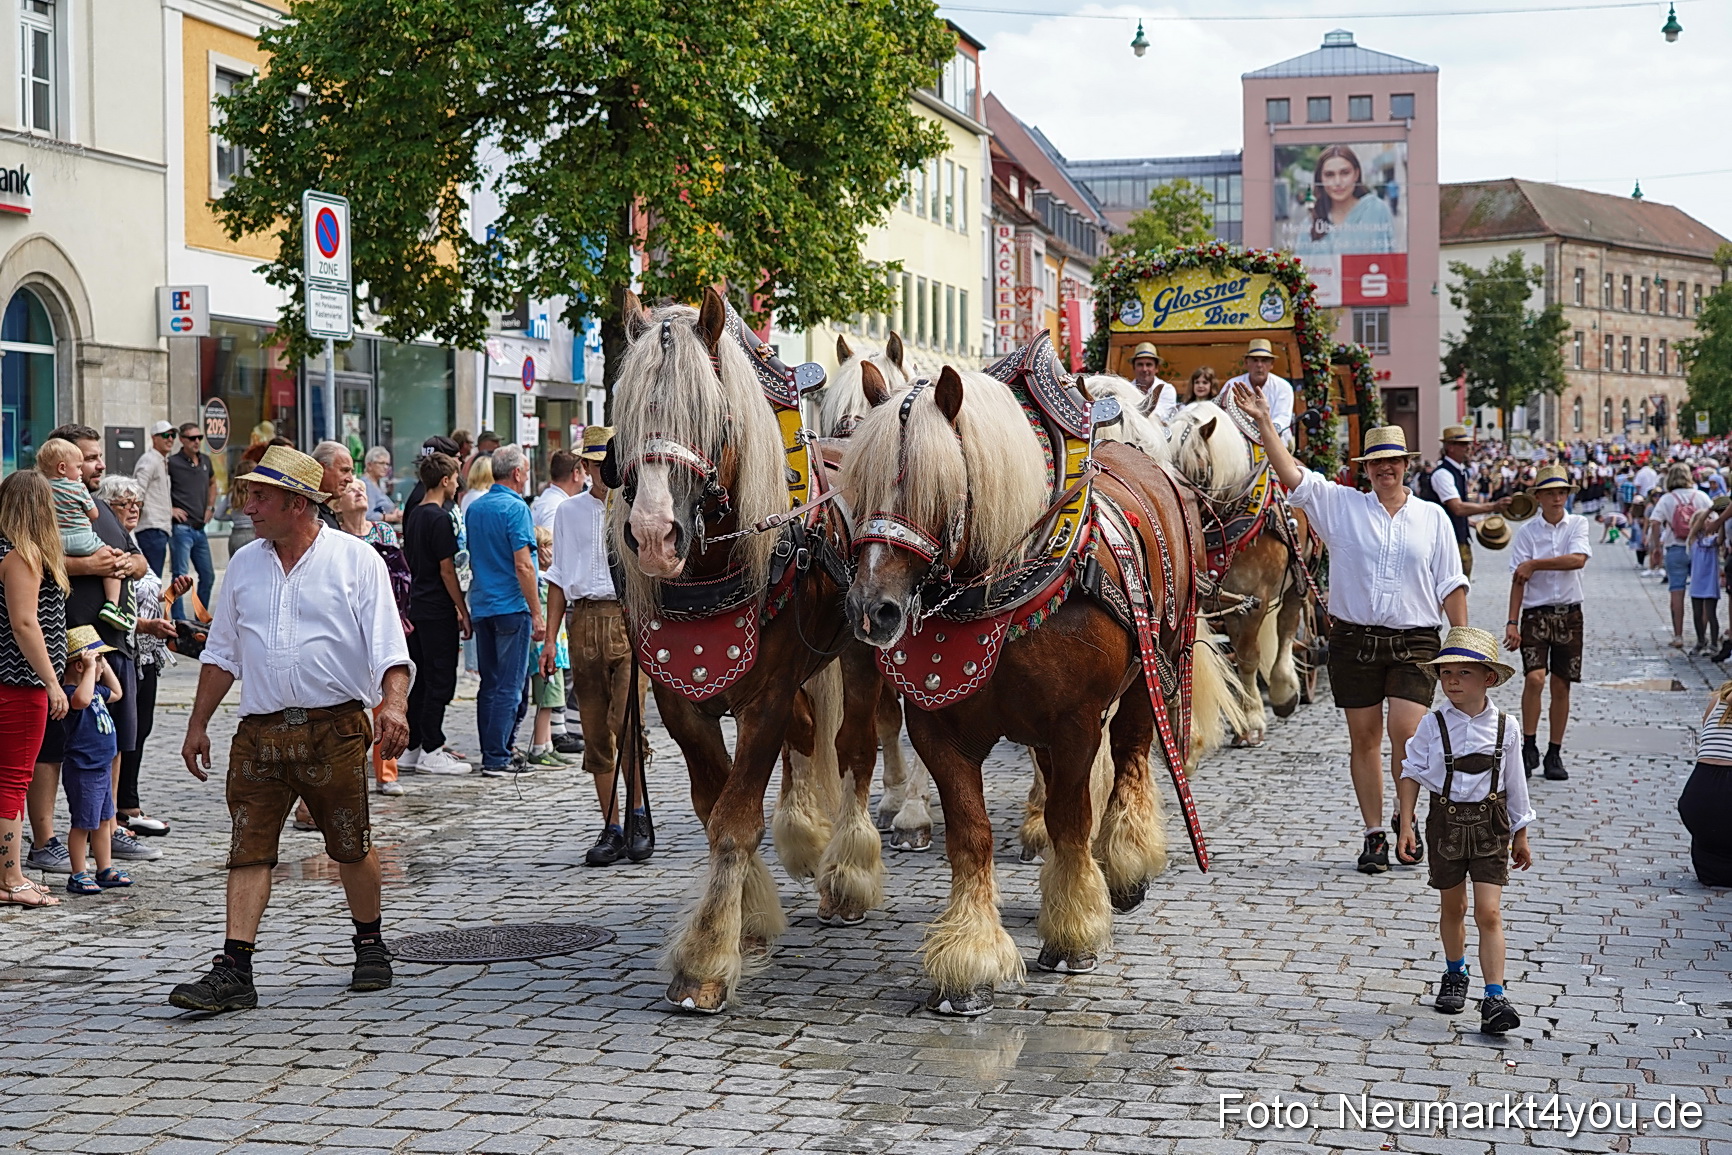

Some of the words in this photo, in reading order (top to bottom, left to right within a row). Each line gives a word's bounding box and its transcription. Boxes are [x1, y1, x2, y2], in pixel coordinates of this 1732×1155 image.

[318, 261, 339, 277] ZONE
[1153, 277, 1251, 328] Glossner
[1204, 305, 1250, 325] Bier
[206, 418, 227, 435] 20%
